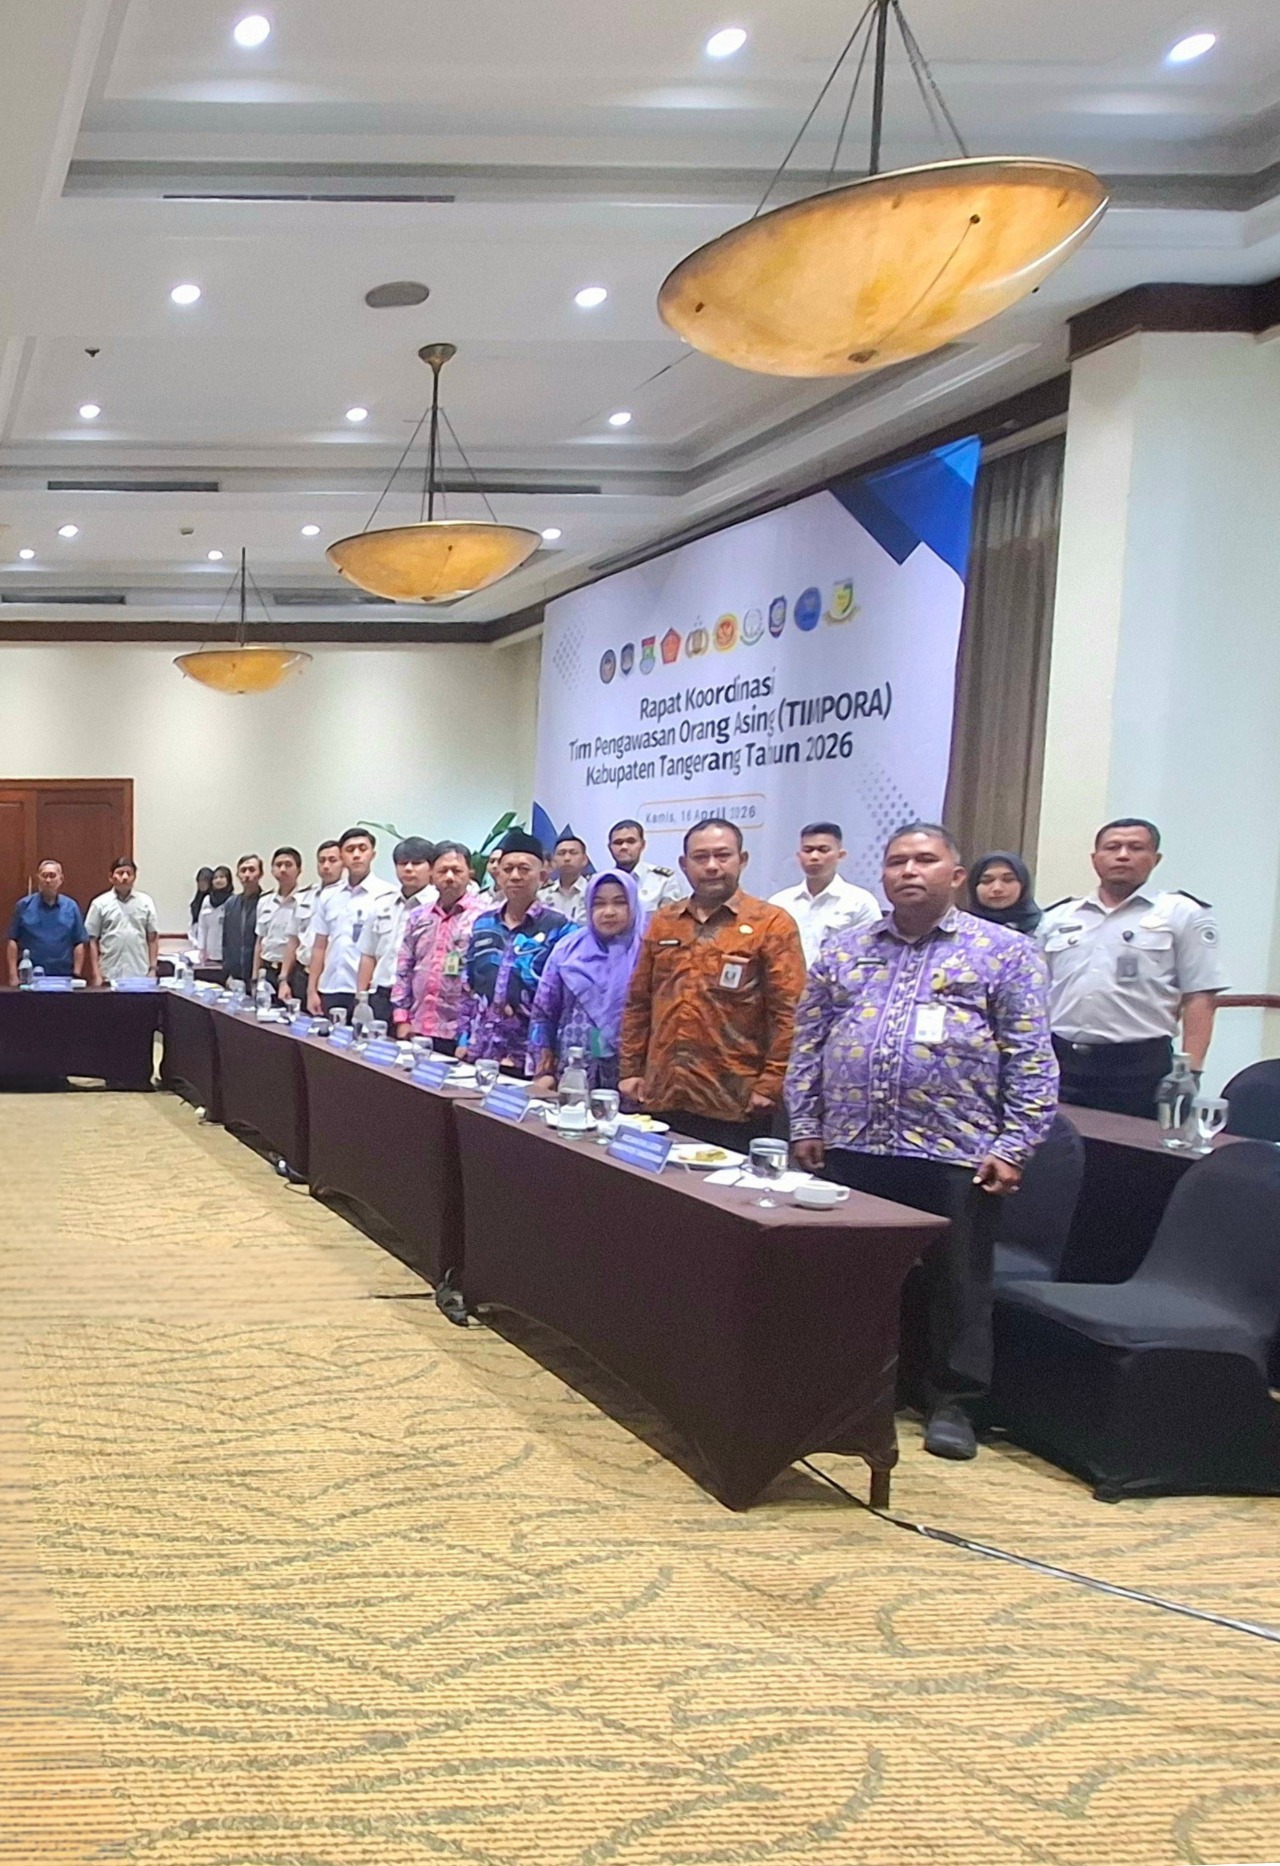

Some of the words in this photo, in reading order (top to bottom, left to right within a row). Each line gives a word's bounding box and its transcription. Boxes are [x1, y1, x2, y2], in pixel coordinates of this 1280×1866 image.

[640, 692, 682, 723] Rapat
[685, 666, 776, 712] Koordinasi
[569, 738, 592, 761] Tim
[594, 726, 676, 760] Pengawasan
[679, 716, 731, 744] Orang
[733, 704, 776, 737] Asing
[586, 760, 655, 789] Kabupaten
[659, 749, 741, 781] Tangerang
[806, 731, 853, 762] 2026
[694, 807, 726, 821] April
